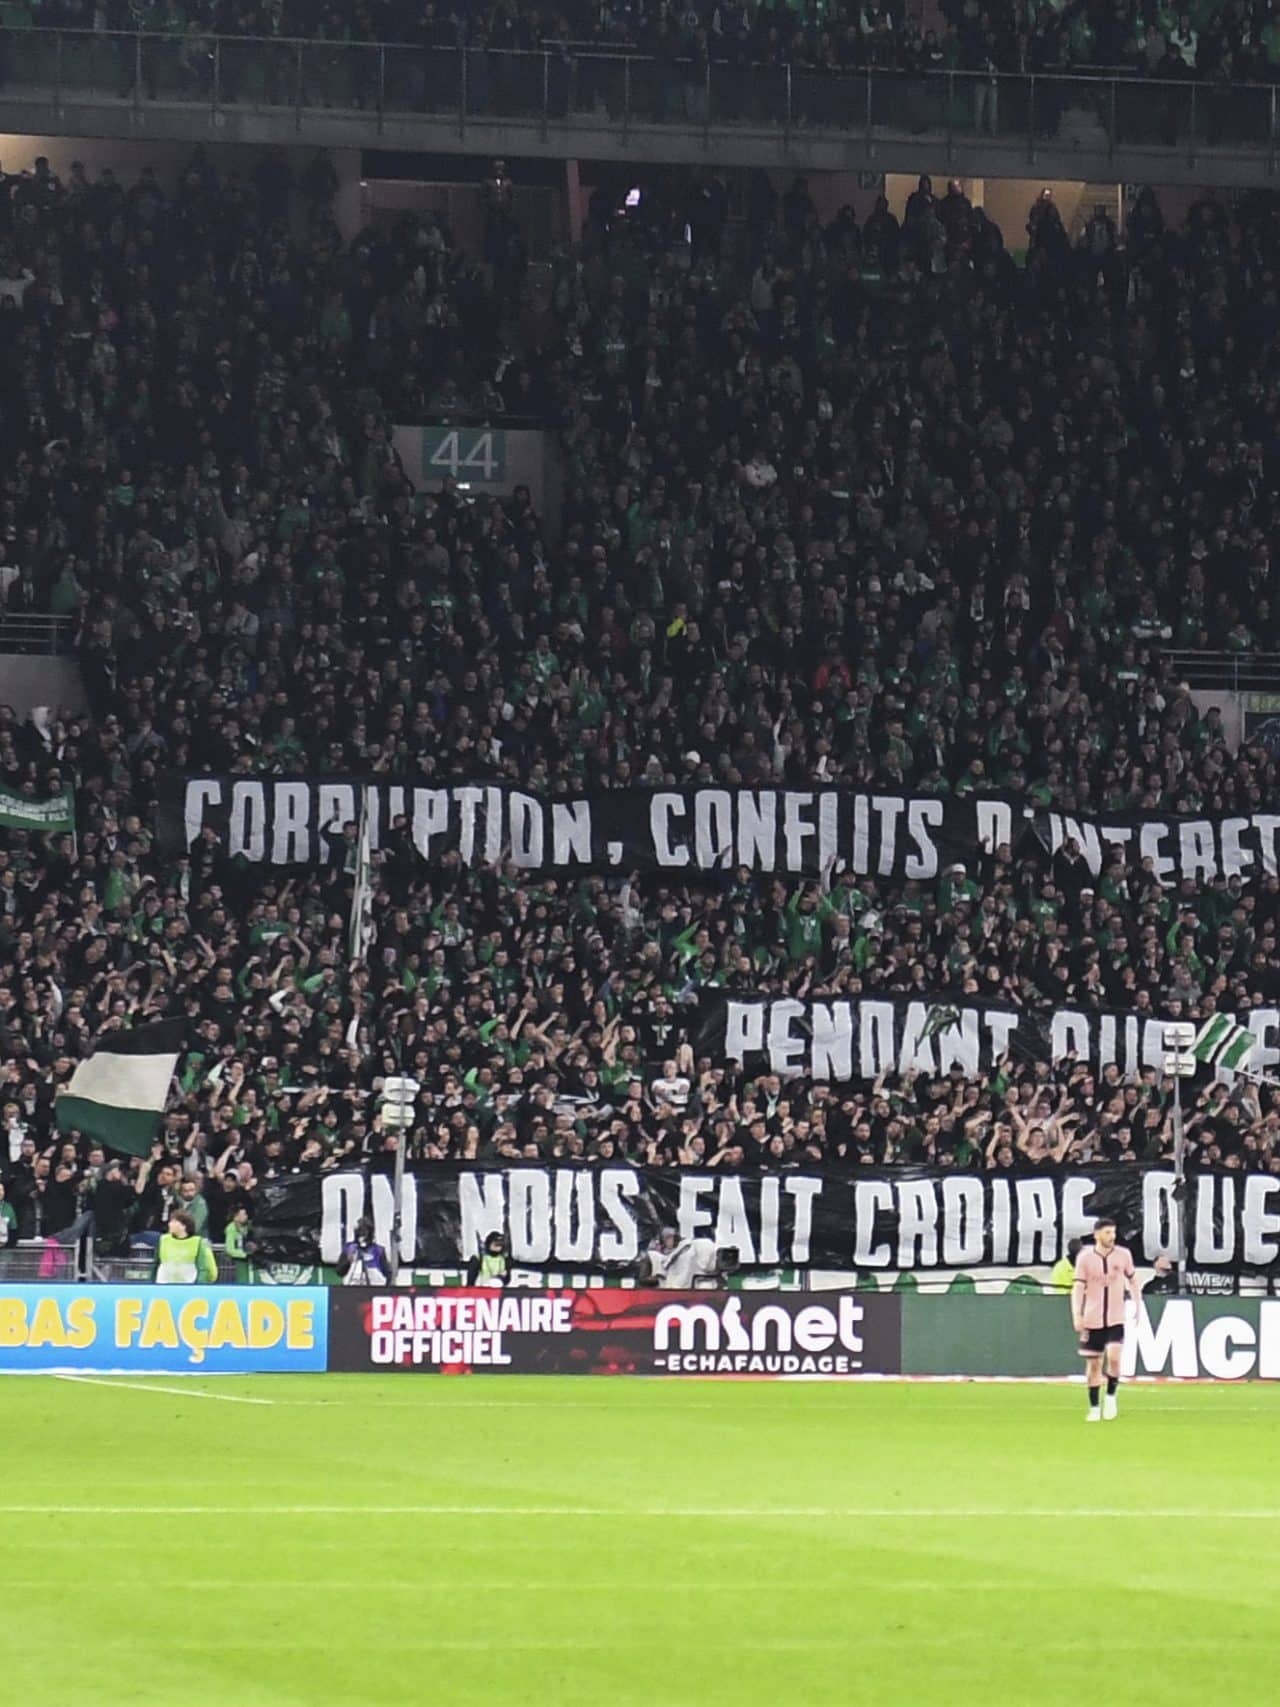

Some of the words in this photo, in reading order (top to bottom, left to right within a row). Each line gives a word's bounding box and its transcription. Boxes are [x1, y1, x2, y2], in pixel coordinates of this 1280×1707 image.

[430, 431, 498, 479] 44
[651, 790, 943, 880] CONFLITS
[724, 998, 1019, 1081] PENDANT
[321, 1173, 417, 1262] ON
[459, 1169, 639, 1262] NOUS
[677, 1176, 822, 1264] FAIT
[854, 1178, 1099, 1268] CROIRE
[0, 1298, 96, 1349] BAS
[114, 1299, 314, 1362] FAÇADE
[371, 1296, 573, 1332] PARTENAIRE
[371, 1331, 511, 1365] OFFICIEL
